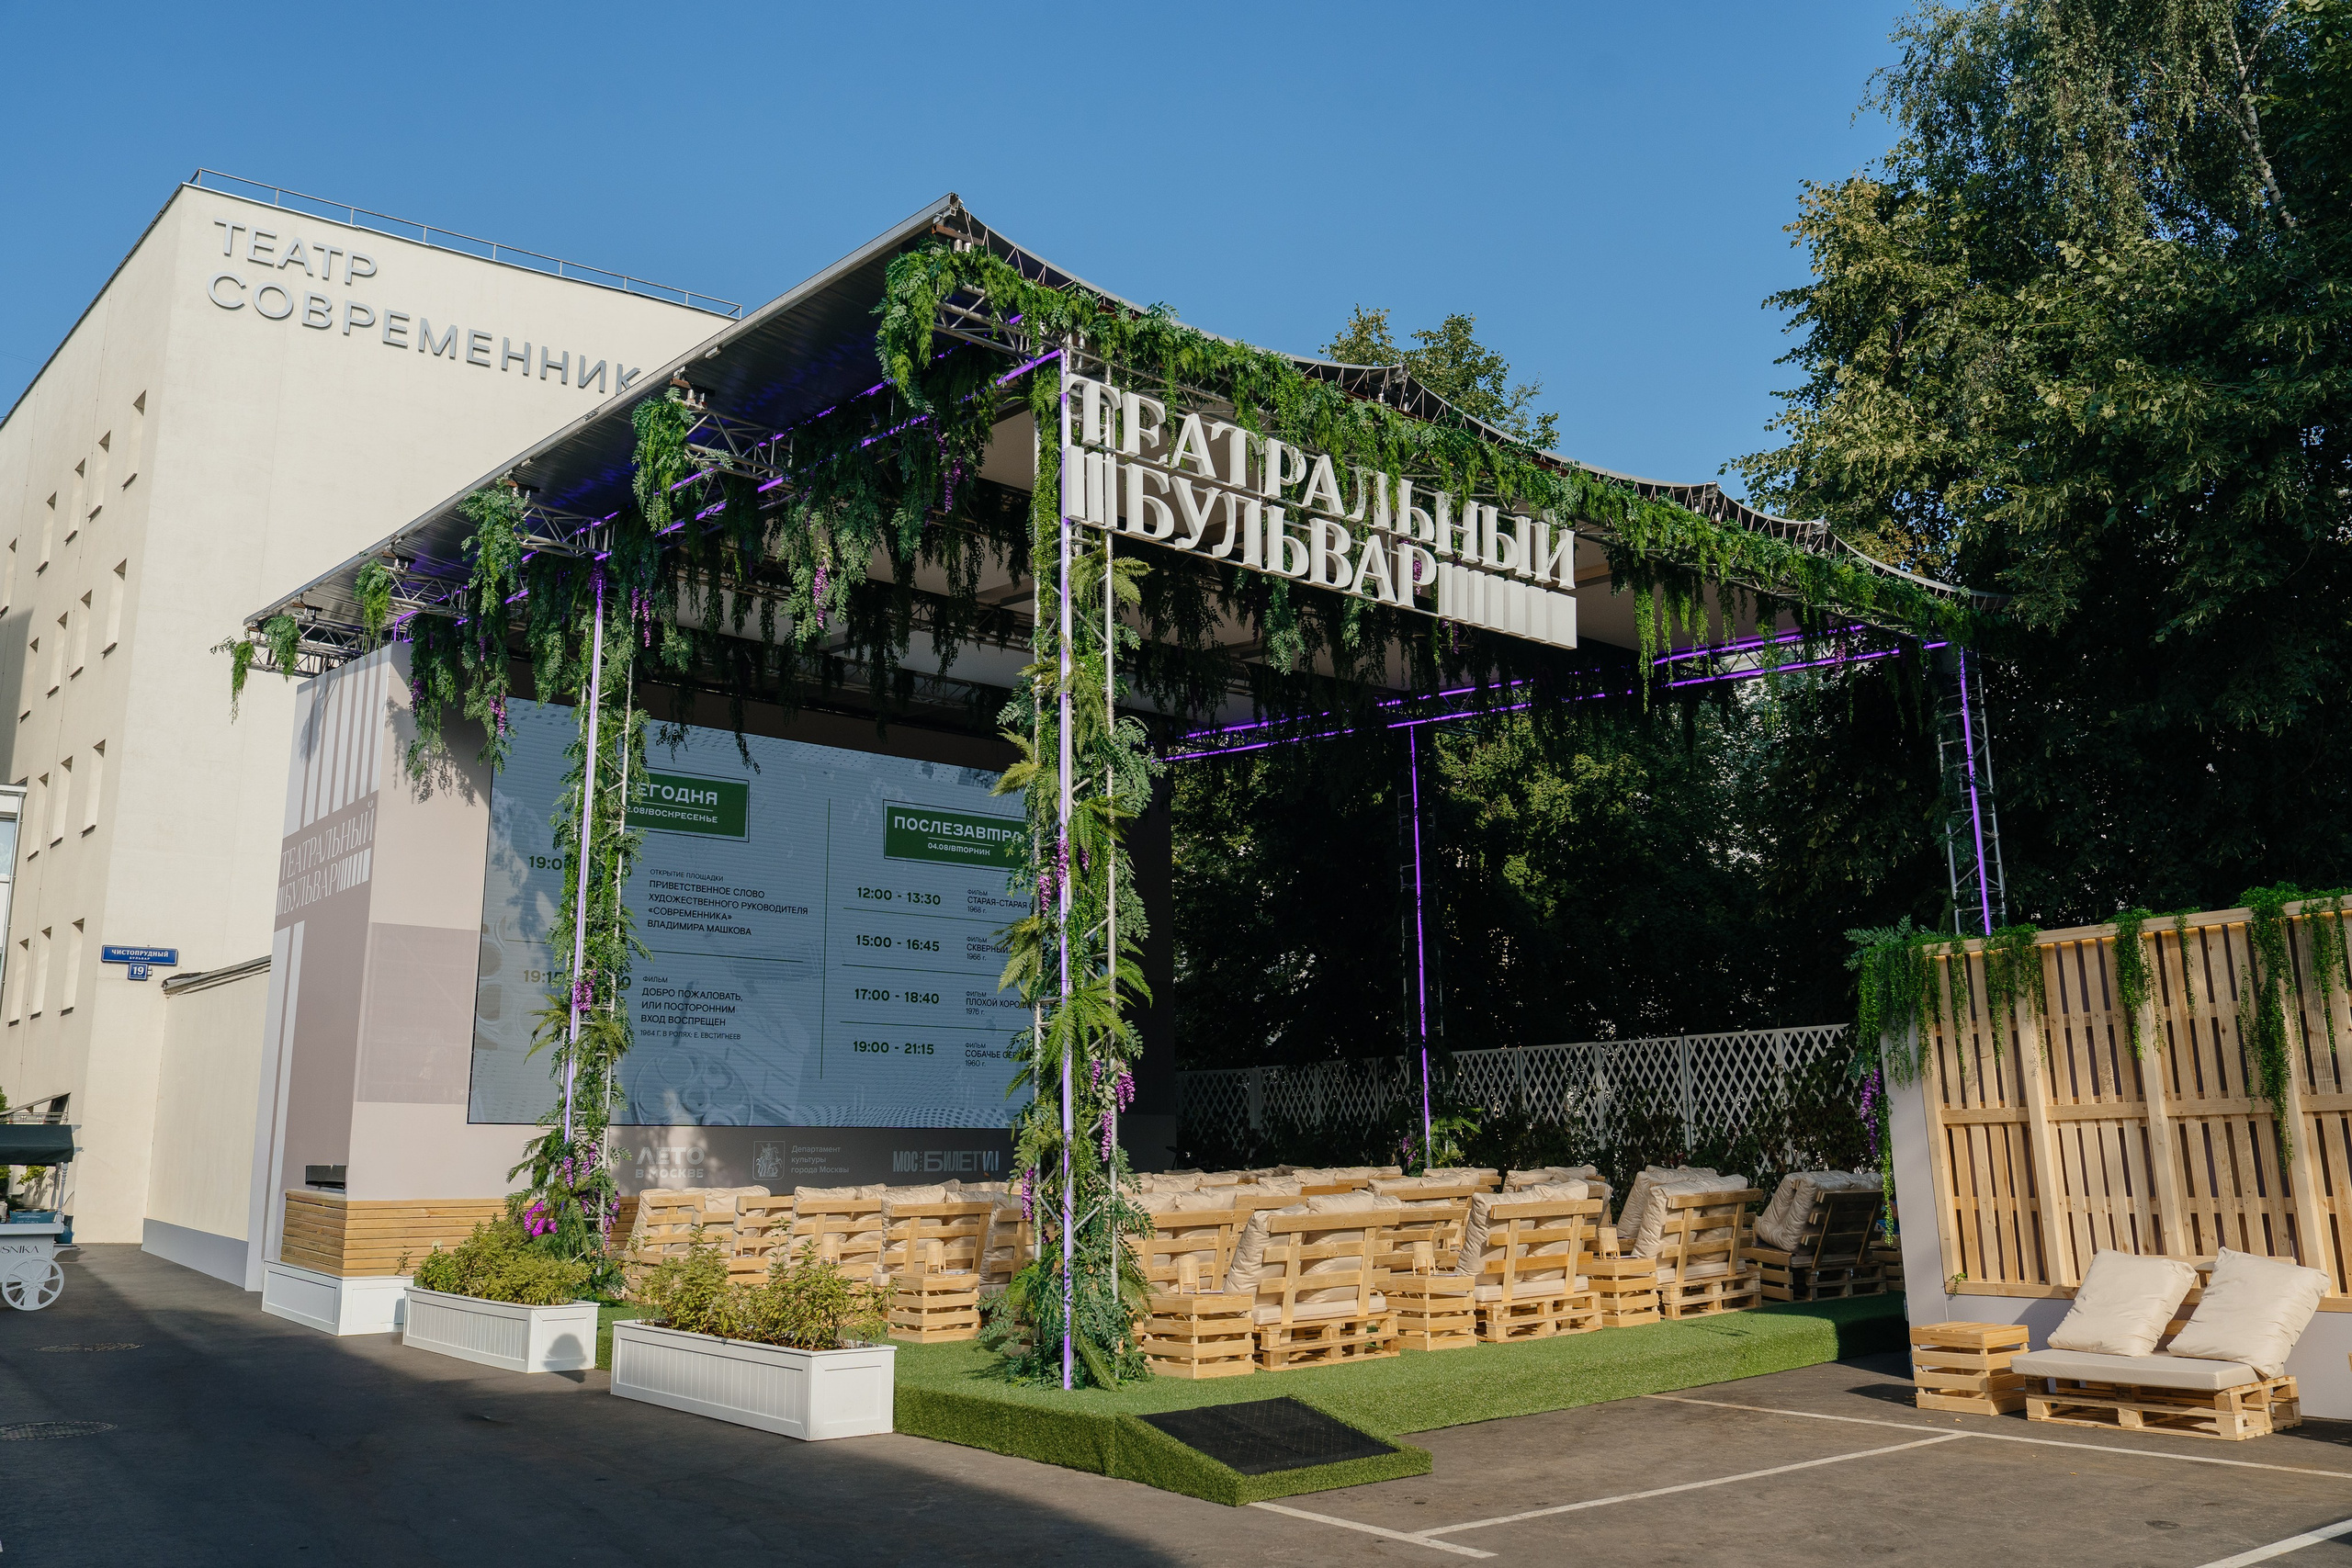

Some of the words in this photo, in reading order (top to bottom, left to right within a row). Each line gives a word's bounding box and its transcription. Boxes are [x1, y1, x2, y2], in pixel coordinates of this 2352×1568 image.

[214, 217, 378, 285] ТЕАТР
[207, 271, 641, 396] СОВРЕМЕННИК
[1061, 372, 1576, 590] ТЕАТРАЛЬНЫЙ
[1124, 463, 1436, 609] БУЛЬВАР
[627, 781, 718, 806] ЕГОДНЯ
[626, 806, 718, 824] 2.08/ВОСКРЕСЕНЬЕ
[281, 799, 375, 881] ТЕАТРАЛЬНЫЙ
[927, 842, 990, 856] 04.08/ВТОРНИК
[529, 855, 566, 871] 19:0
[650, 869, 685, 878] ОТКРЫТИЕ
[685, 873, 724, 882] ПЛОЩАДКИ
[283, 863, 338, 914] БУЛЬВАР
[649, 880, 730, 896] ПРИВЕТСТВЕННОЕ
[732, 888, 765, 898] СЛОВО
[967, 888, 988, 897] ФИЛЬМ
[857, 886, 892, 900] 12:00
[907, 892, 941, 906] 13:30
[967, 896, 1027, 908] СТАРАЯ-СТАРАЯ
[648, 893, 740, 909] ХУДОЖЕСТВЕННОГО
[741, 902, 808, 915] РУКОВОДИТЕЛЯ
[648, 907, 732, 920] «СОВРЕМЕННИКА»
[647, 919, 705, 931] ВЛАДИМИРА
[707, 925, 752, 935] МАШКОВА
[855, 934, 892, 948] 15:00
[906, 939, 940, 952] 16:45
[111, 949, 169, 957] ЧИСТОПРУДНЫЙ
[132, 966, 144, 976] 19
[642, 987, 675, 997] ДОБРО
[677, 989, 743, 1001] ПОЖАЛОВАТЬ,
[854, 988, 890, 1001] 17:00
[904, 991, 940, 1004] 18:40
[641, 1001, 662, 1010] ИЛИ
[663, 1002, 736, 1013] ПОСТОРОННИМ
[966, 998, 998, 1007] ПЛОХОЙ
[640, 1014, 666, 1024] ВХОД
[668, 1016, 726, 1027] ВОСПРЕЩЕН
[853, 1041, 889, 1053] 19:00
[904, 1043, 934, 1055] 21:15
[965, 1050, 1001, 1059] СОБАЧЬЕ
[636, 1146, 705, 1165] ЛЕТО
[791, 1145, 841, 1154] Департамент
[791, 1156, 827, 1164] культуры
[635, 1169, 643, 1178] В
[648, 1168, 704, 1179] МОСКВЕ
[791, 1166, 818, 1174] города
[819, 1166, 850, 1174] Москвы
[0, 1245, 40, 1254] SNIKA
